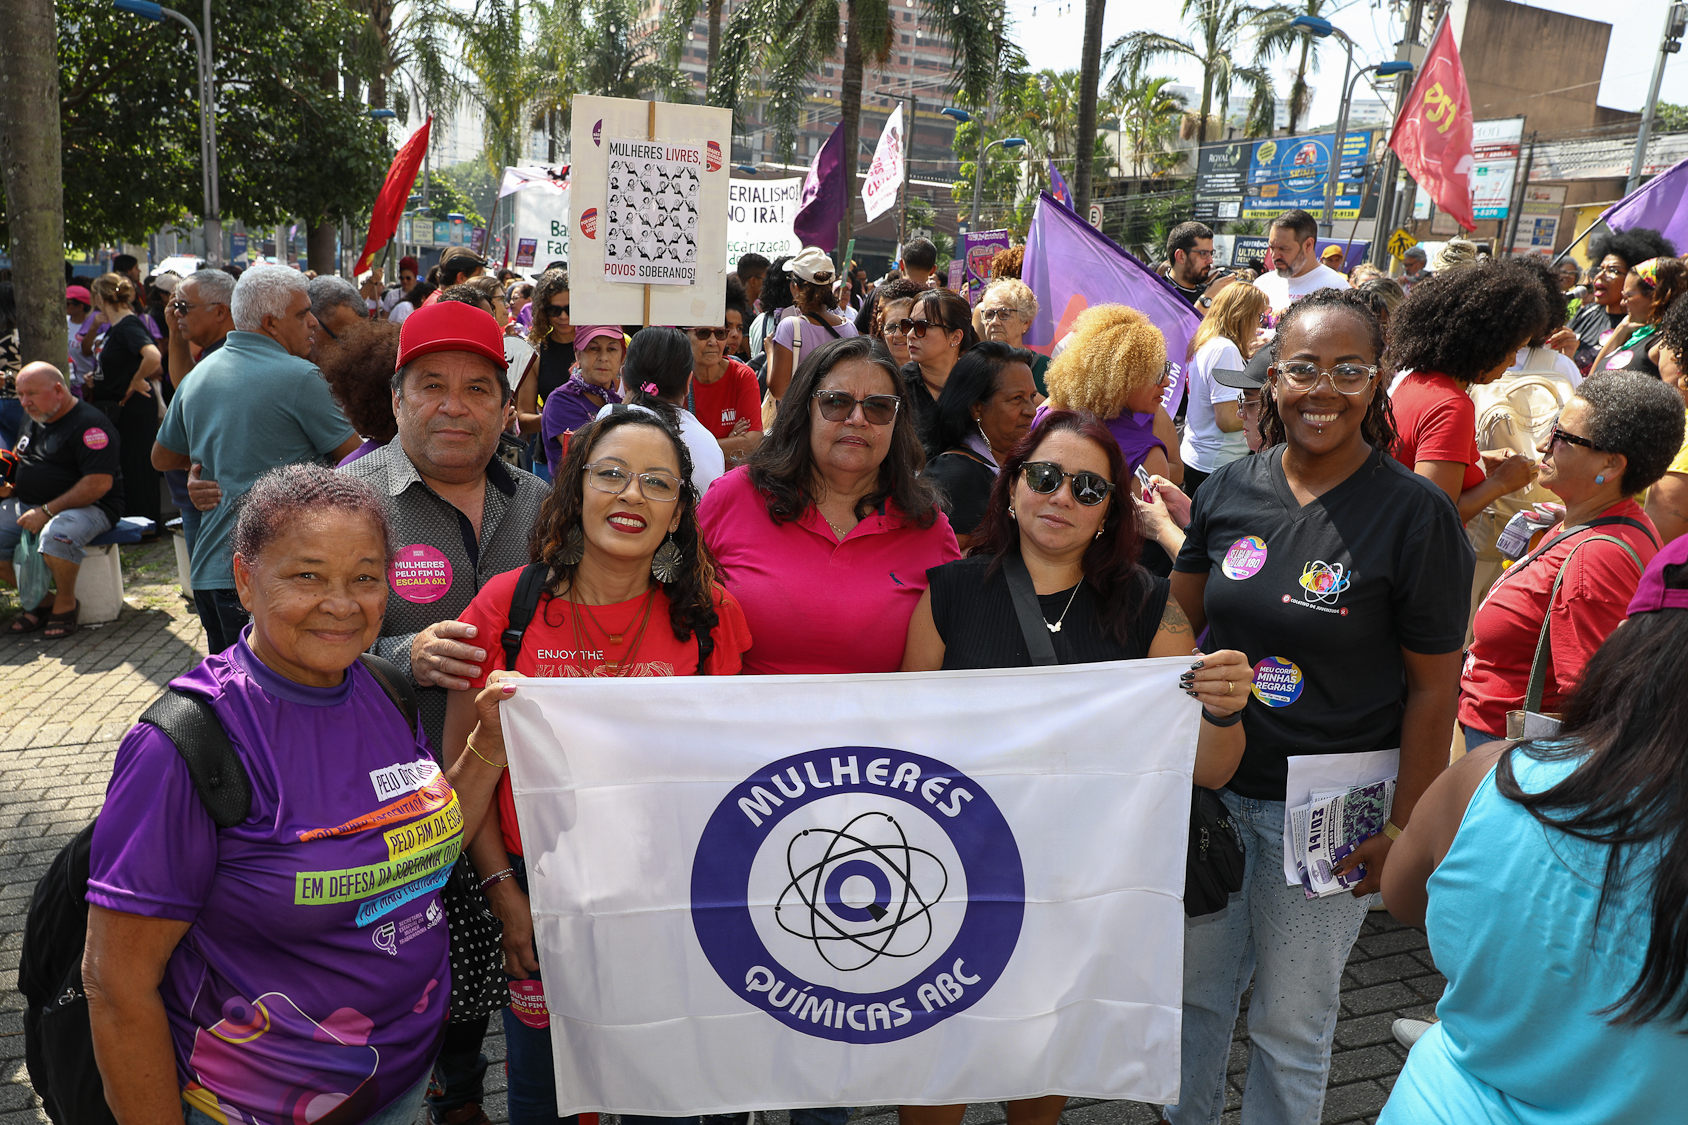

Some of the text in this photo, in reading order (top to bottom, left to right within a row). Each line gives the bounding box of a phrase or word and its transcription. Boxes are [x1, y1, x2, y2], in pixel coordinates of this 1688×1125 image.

[609, 142, 663, 160] MULHERES
[666, 147, 701, 165] LIVRES,
[729, 183, 799, 203] ERIALISMO!
[1090, 211, 1097, 224] E
[604, 263, 696, 280] POVOS SOBERANOS!
[394, 560, 446, 570] MULHERES
[1245, 558, 1262, 569] 180
[395, 570, 417, 578] PELO
[396, 577, 447, 587] ESCALA 6X1
[537, 649, 605, 661] ENJOY THE
[1257, 672, 1298, 684] MINHAS
[1274, 667, 1299, 676] CORPO
[1255, 681, 1297, 693] REGRAS!
[377, 770, 401, 795] PELO
[738, 755, 974, 828] MULHERES
[390, 829, 415, 856] PELO
[415, 821, 434, 846] FIM
[433, 815, 448, 838] DA
[302, 877, 324, 899] EM
[329, 870, 375, 898] DEFESA
[377, 865, 392, 888] DA
[745, 957, 982, 1032] QUÍMICAS ABC
[510, 996, 528, 1008] PELO
[511, 1002, 541, 1015] ESCALA
